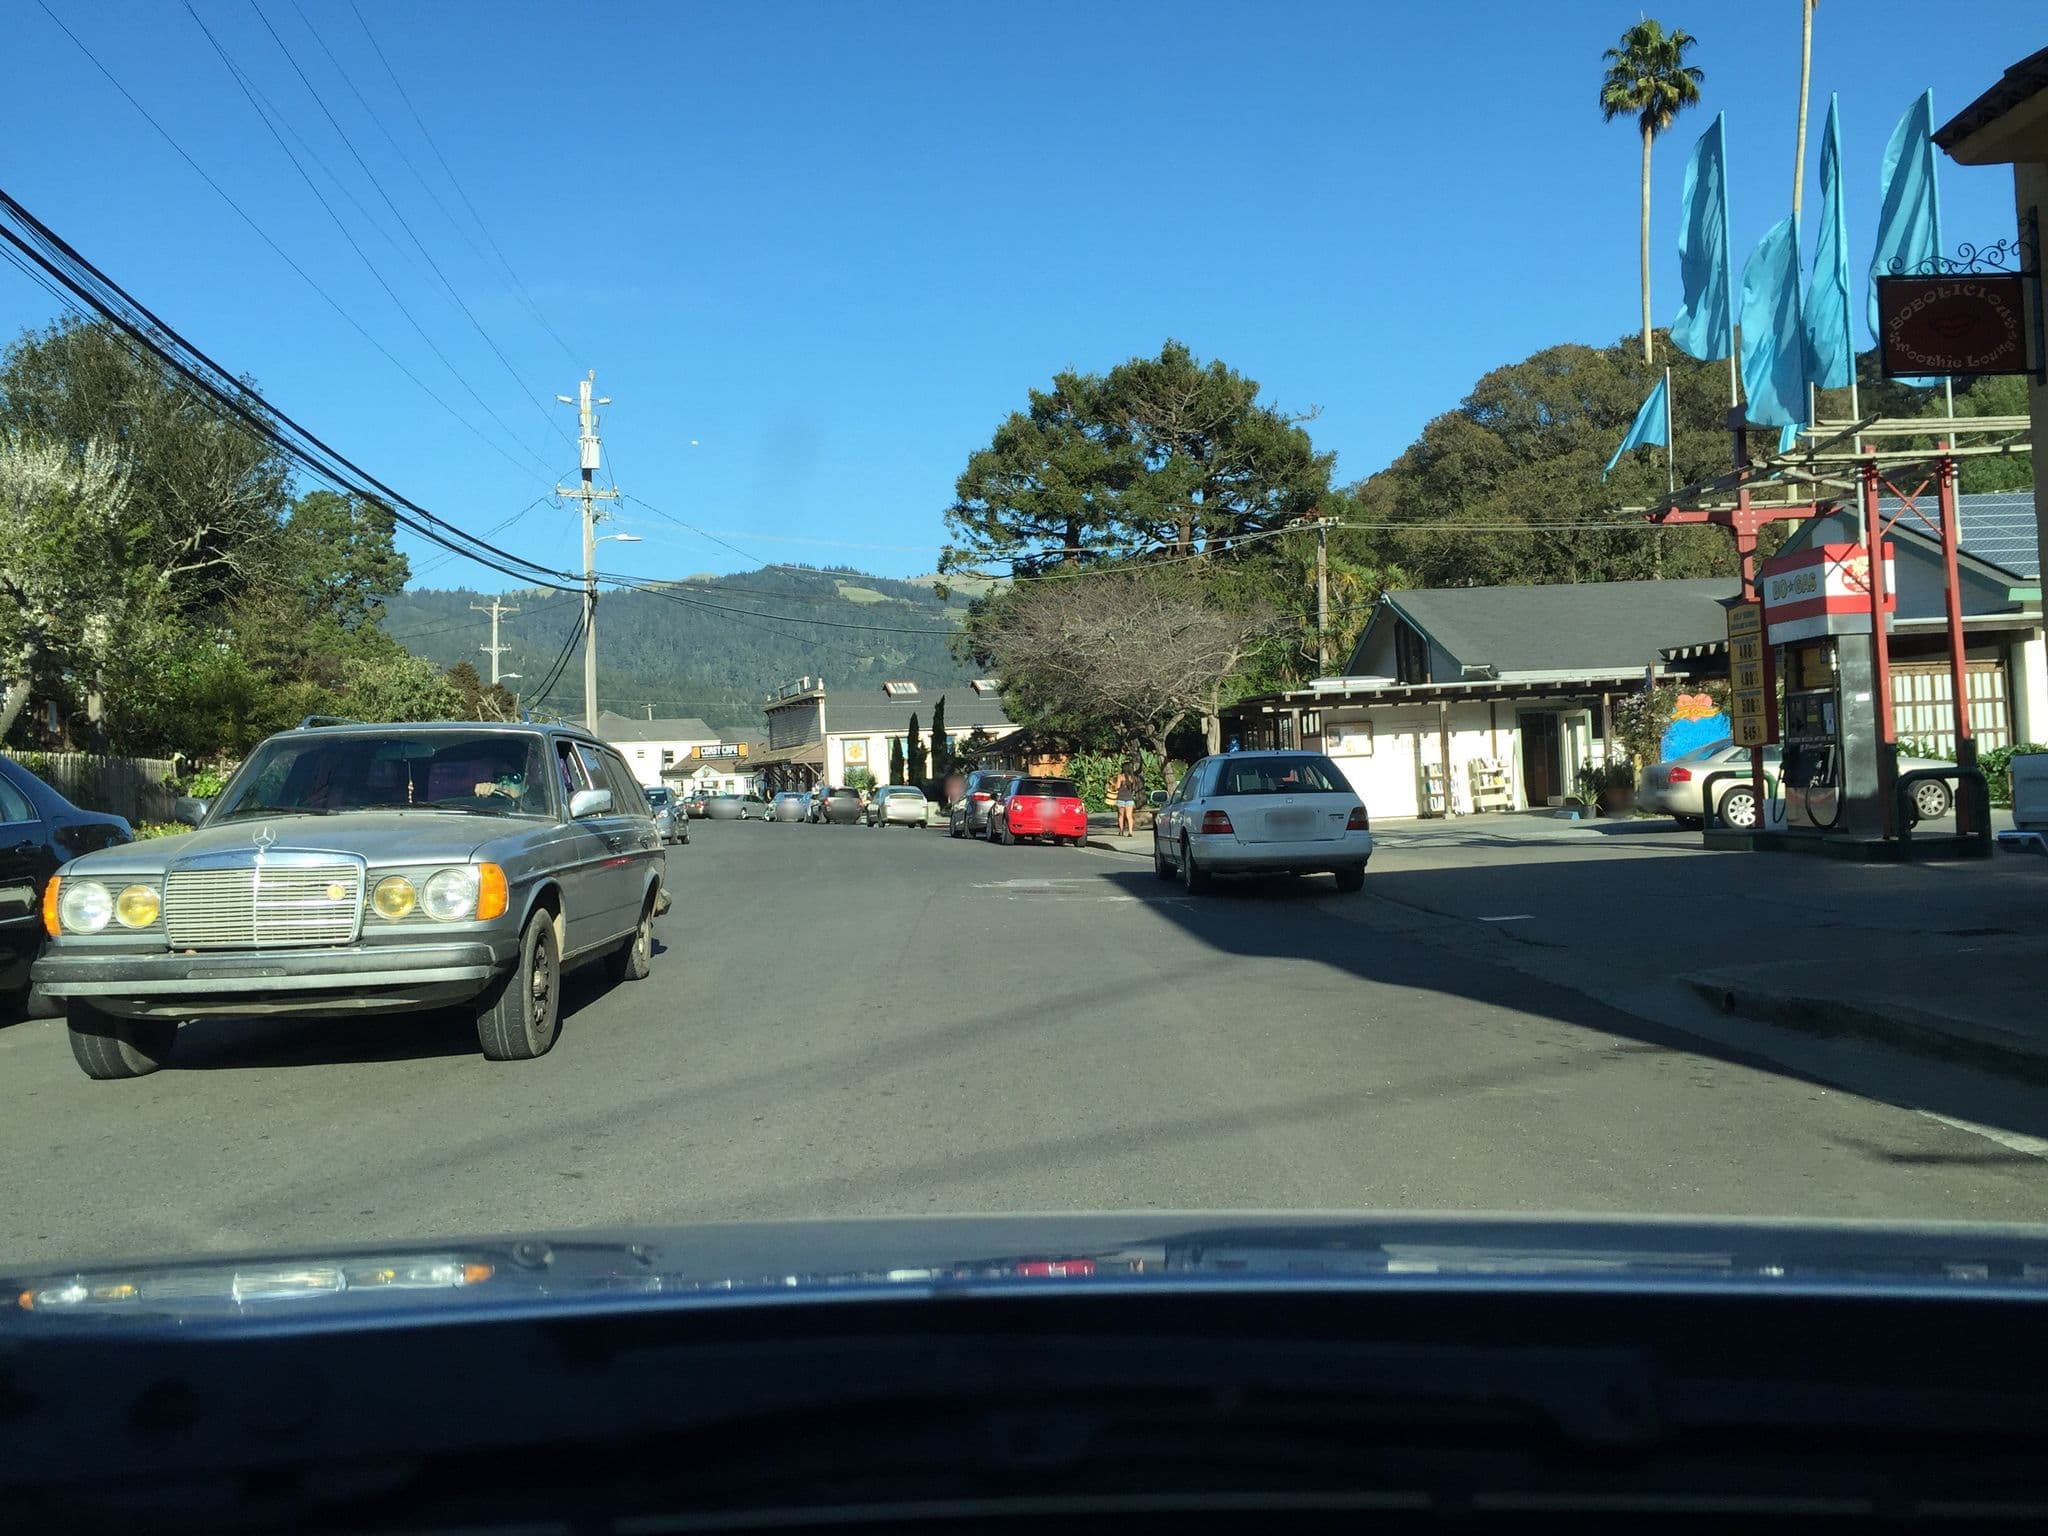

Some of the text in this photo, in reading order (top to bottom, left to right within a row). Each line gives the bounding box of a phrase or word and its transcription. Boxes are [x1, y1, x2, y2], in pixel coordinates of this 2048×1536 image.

[1888, 284, 2017, 330] BOBOLICIOUS
[1889, 330, 2017, 369] Smoothie Lounge
[701, 744, 738, 755] COAST CAFE
